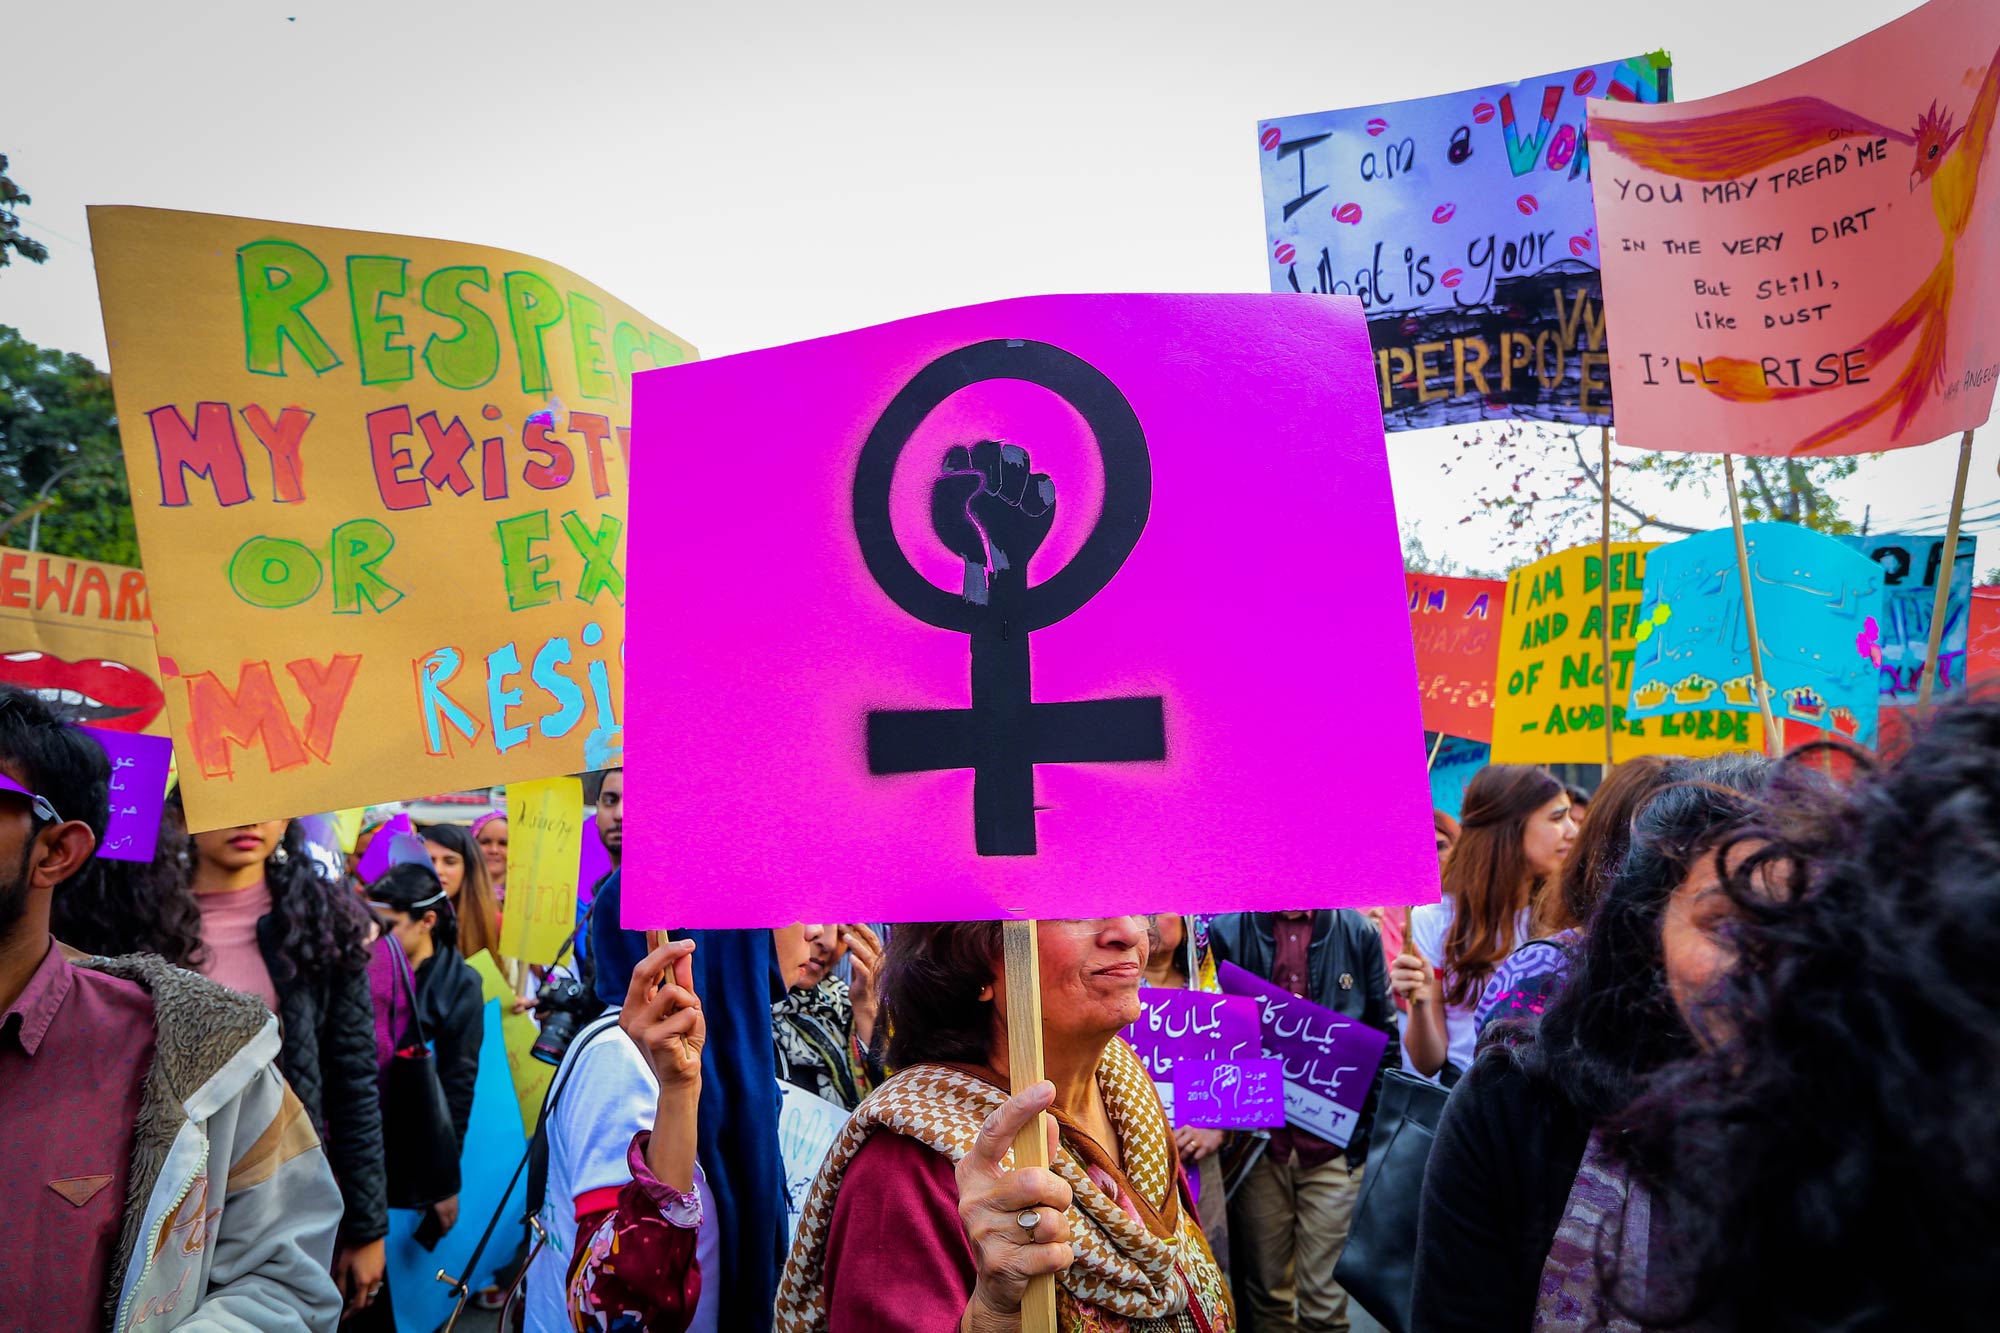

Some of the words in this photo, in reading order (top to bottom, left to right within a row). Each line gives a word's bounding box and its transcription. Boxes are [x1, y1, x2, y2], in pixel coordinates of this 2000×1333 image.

[1276, 131, 1334, 223] I
[1360, 137, 1415, 182] am
[1447, 125, 1475, 165] a
[1613, 177, 1684, 205] YOU
[1702, 177, 1759, 205] MAY
[1767, 153, 1848, 195] TREAD
[1856, 137, 1889, 168] ME
[1621, 238, 1646, 253] IN
[1662, 238, 1703, 256] THE
[1721, 231, 1785, 256] VERY
[1811, 207, 1877, 245] DIRT
[1403, 246, 1436, 298] is
[1453, 229, 1556, 308] your
[1694, 278, 1732, 298] But
[1695, 310, 1738, 331] like
[1763, 303, 1832, 330] DUST
[1760, 348, 1872, 389] RISE
[1963, 361, 2000, 392] ANGELO
[145, 401, 316, 507] MY
[366, 404, 631, 511] EXiST
[0, 552, 152, 621] EWAR
[229, 518, 405, 614] OR
[1526, 564, 1565, 612] AM
[1582, 550, 1648, 595] DEL
[1519, 611, 1569, 651] AND
[182, 653, 362, 781] MY
[412, 622, 625, 760] RESi
[1507, 660, 1544, 696] OF
[1660, 710, 1750, 743] LORDE
